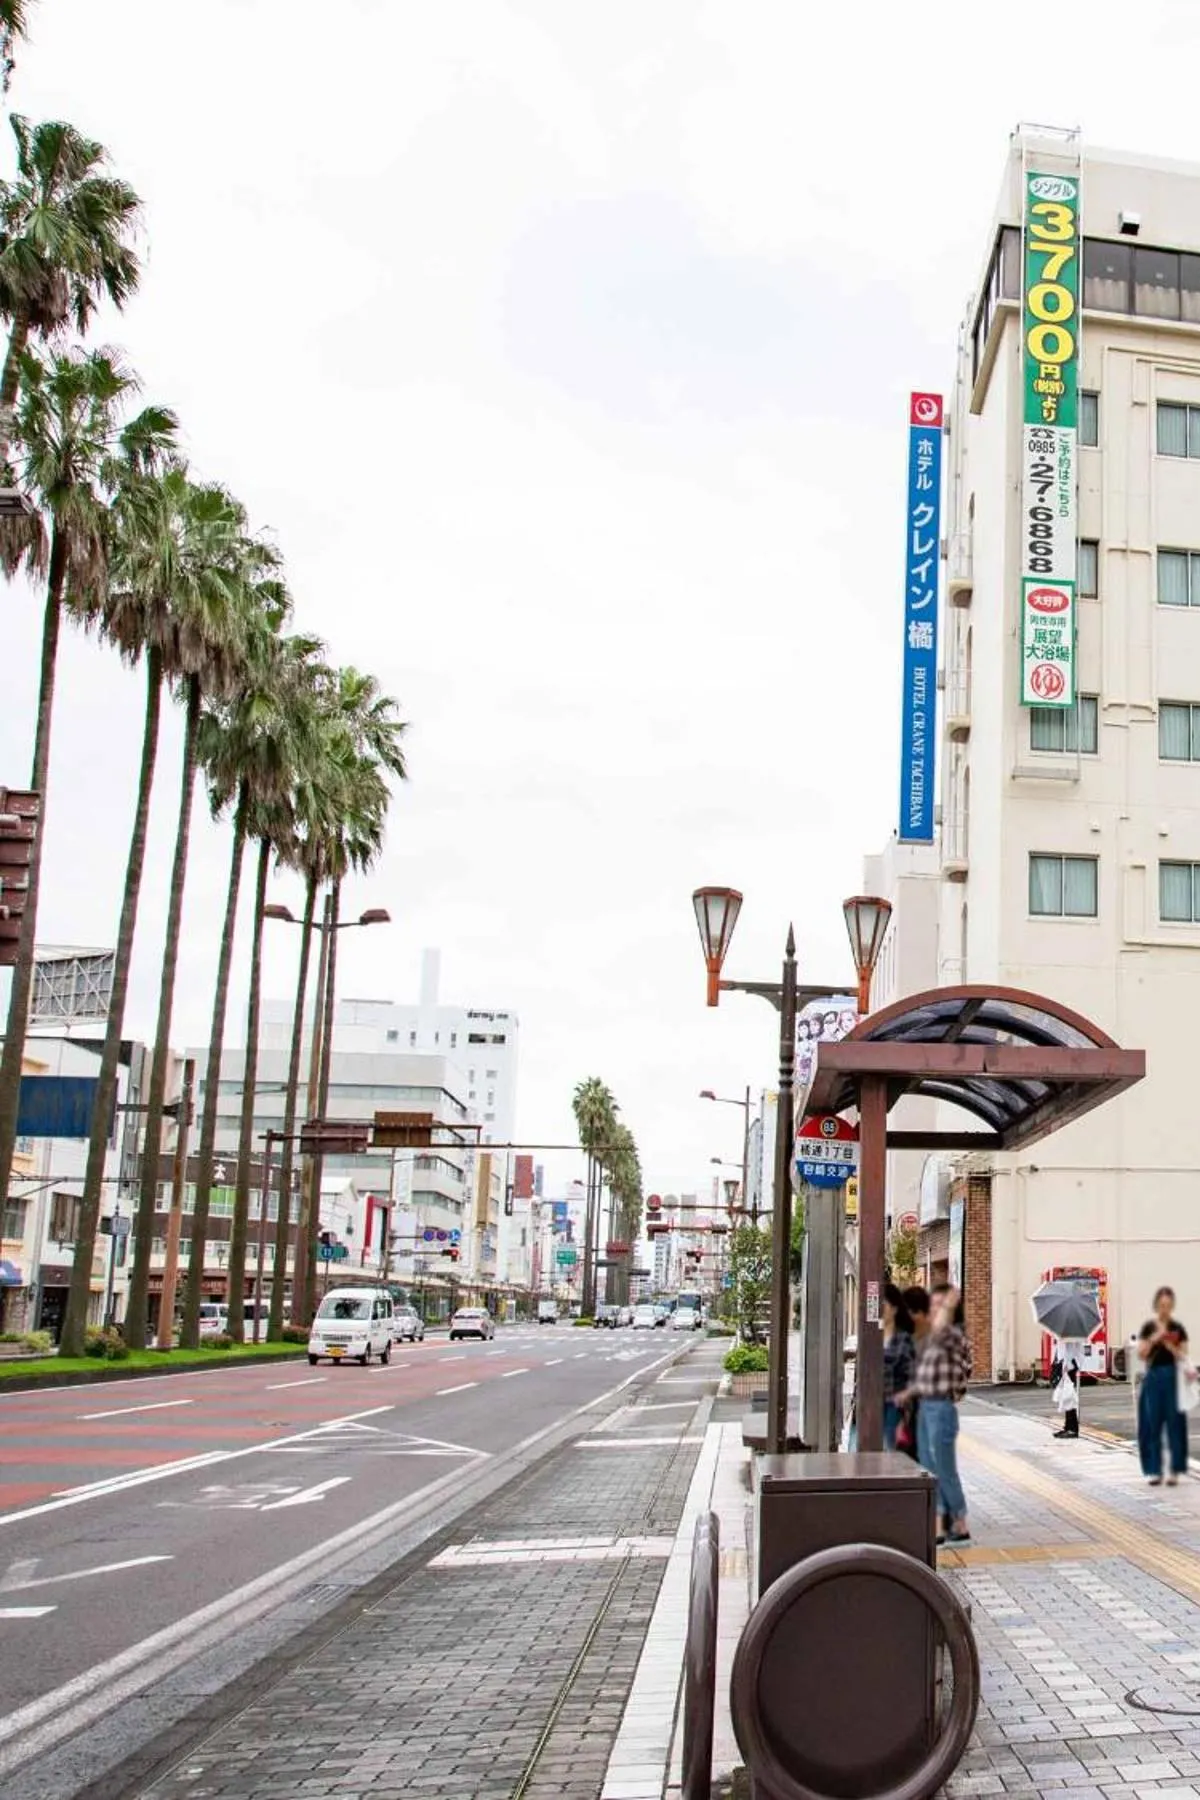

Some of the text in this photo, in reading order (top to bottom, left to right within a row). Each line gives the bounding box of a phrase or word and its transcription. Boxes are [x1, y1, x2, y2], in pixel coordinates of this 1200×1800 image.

[1033, 180, 1073, 197] シングル
[916, 438, 934, 490] ホテル
[911, 502, 935, 610] クレイン
[1034, 628, 1062, 644] 展望
[1026, 644, 1070, 662] 大浴場
[1032, 667, 1062, 697] ゆ
[910, 666, 926, 829] HOTEL CRANE TACHIBANA
[467, 1008, 494, 1022] dormy
[803, 1163, 849, 1178] 宮崎交通
